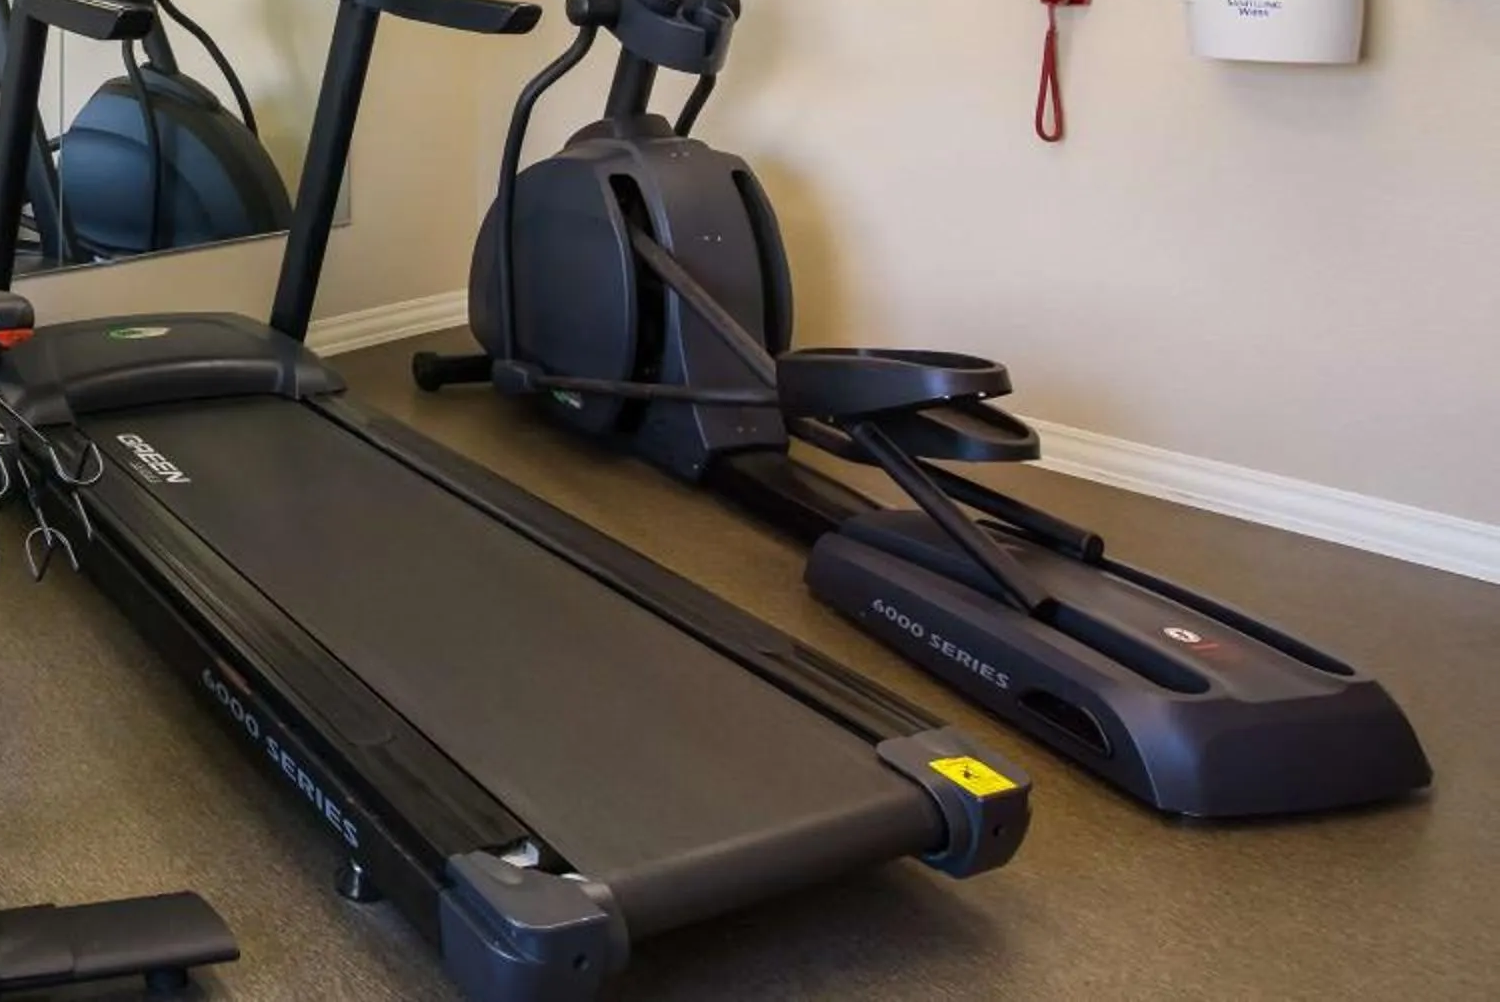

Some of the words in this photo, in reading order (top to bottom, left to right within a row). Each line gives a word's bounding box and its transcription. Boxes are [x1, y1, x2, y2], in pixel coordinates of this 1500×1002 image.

[116, 433, 192, 483] GREEN
[872, 598, 924, 638] 6000
[928, 632, 1011, 690] SERIES
[202, 668, 259, 739] 6000
[266, 735, 359, 848] SERIES
